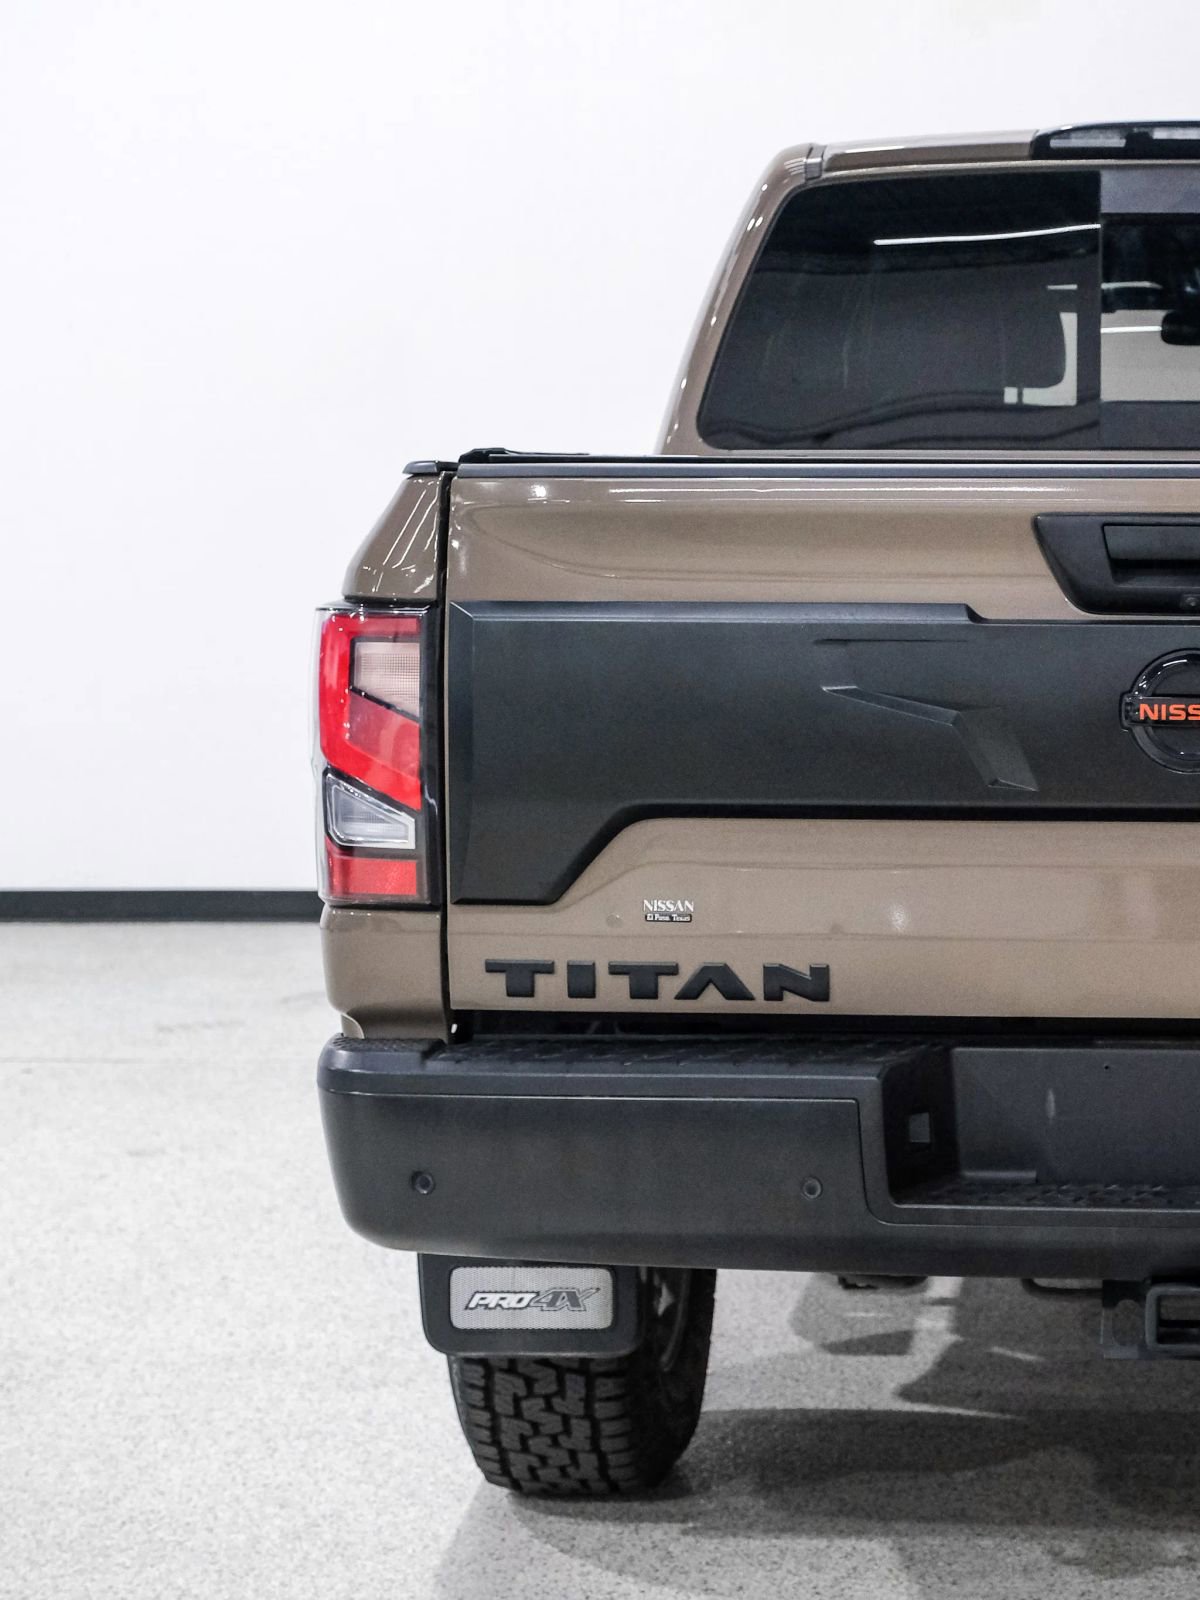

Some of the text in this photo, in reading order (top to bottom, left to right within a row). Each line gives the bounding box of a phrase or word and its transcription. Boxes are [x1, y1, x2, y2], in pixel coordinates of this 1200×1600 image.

[643, 899, 695, 912] NISSAN
[484, 959, 830, 1001] TITAN
[464, 1287, 601, 1312] PRO4X
